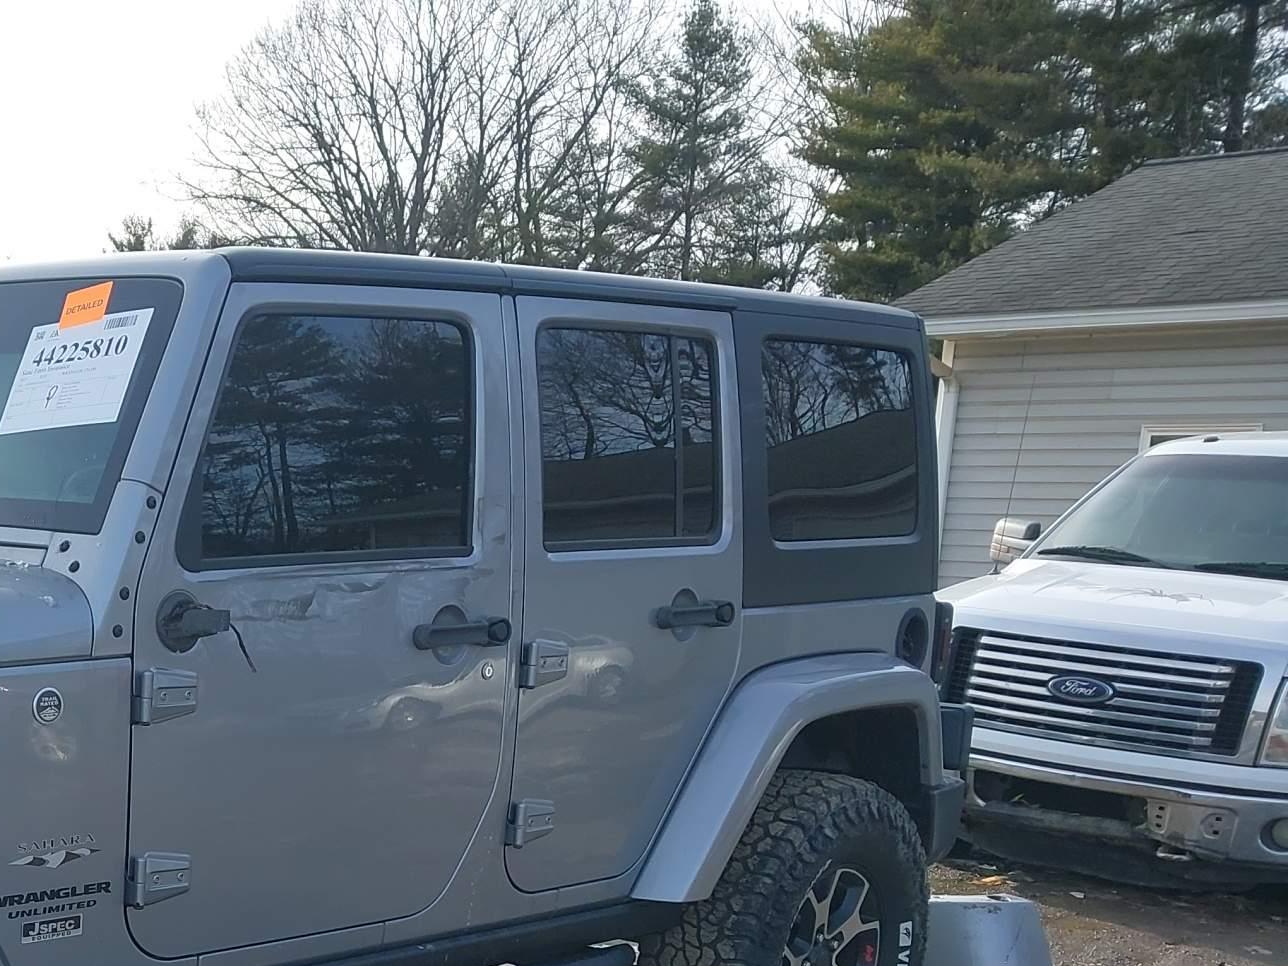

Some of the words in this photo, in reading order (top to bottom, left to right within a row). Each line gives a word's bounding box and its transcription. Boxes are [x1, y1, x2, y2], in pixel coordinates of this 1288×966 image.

[65, 299, 104, 315] DETAILED
[32, 335, 129, 367] 44225810
[1060, 679, 1098, 696] Ford
[17, 832, 96, 852] SAHARA
[8, 899, 98, 920] UNLIMITED
[31, 929, 73, 942] EQUIPPED
